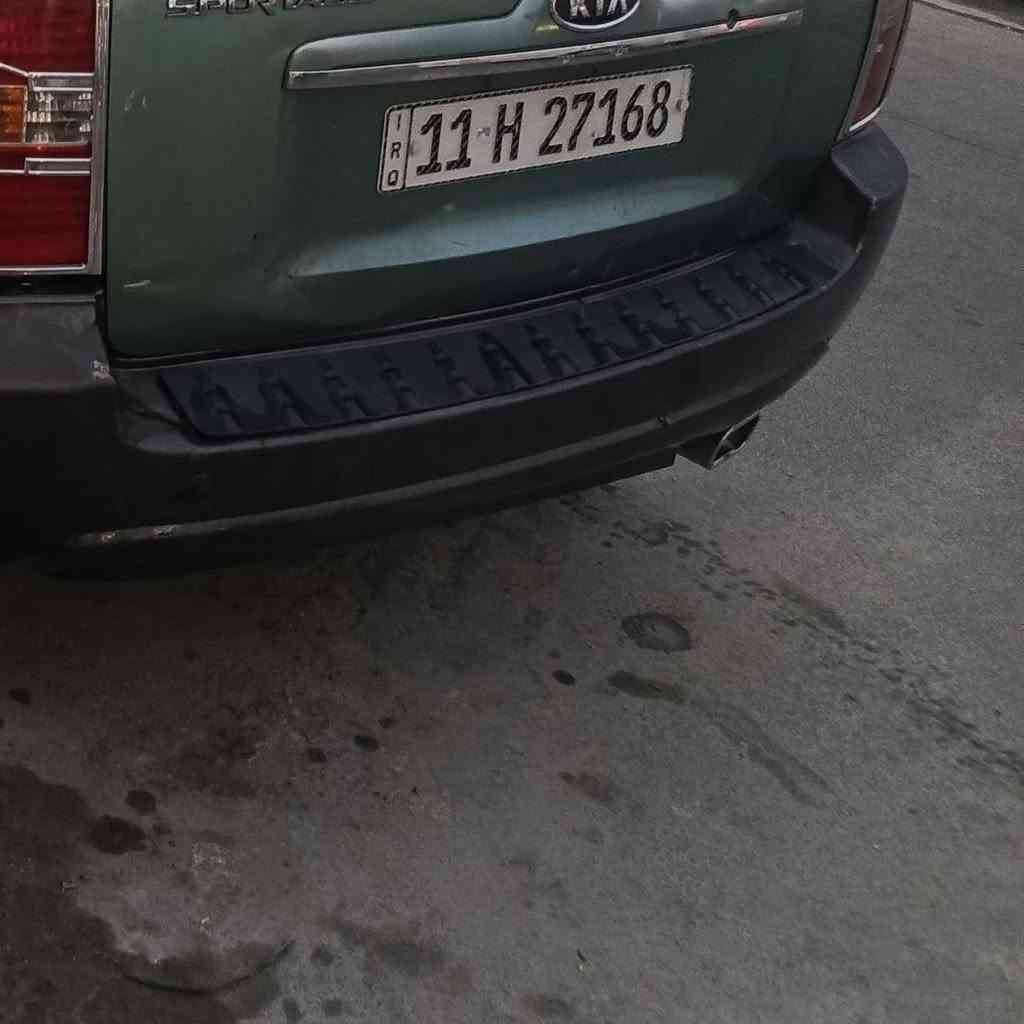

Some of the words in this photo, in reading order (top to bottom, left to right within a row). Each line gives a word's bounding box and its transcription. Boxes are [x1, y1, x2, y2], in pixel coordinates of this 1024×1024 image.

[415, 108, 473, 176] 11
[491, 101, 525, 164] H
[538, 80, 672, 157] 27168
